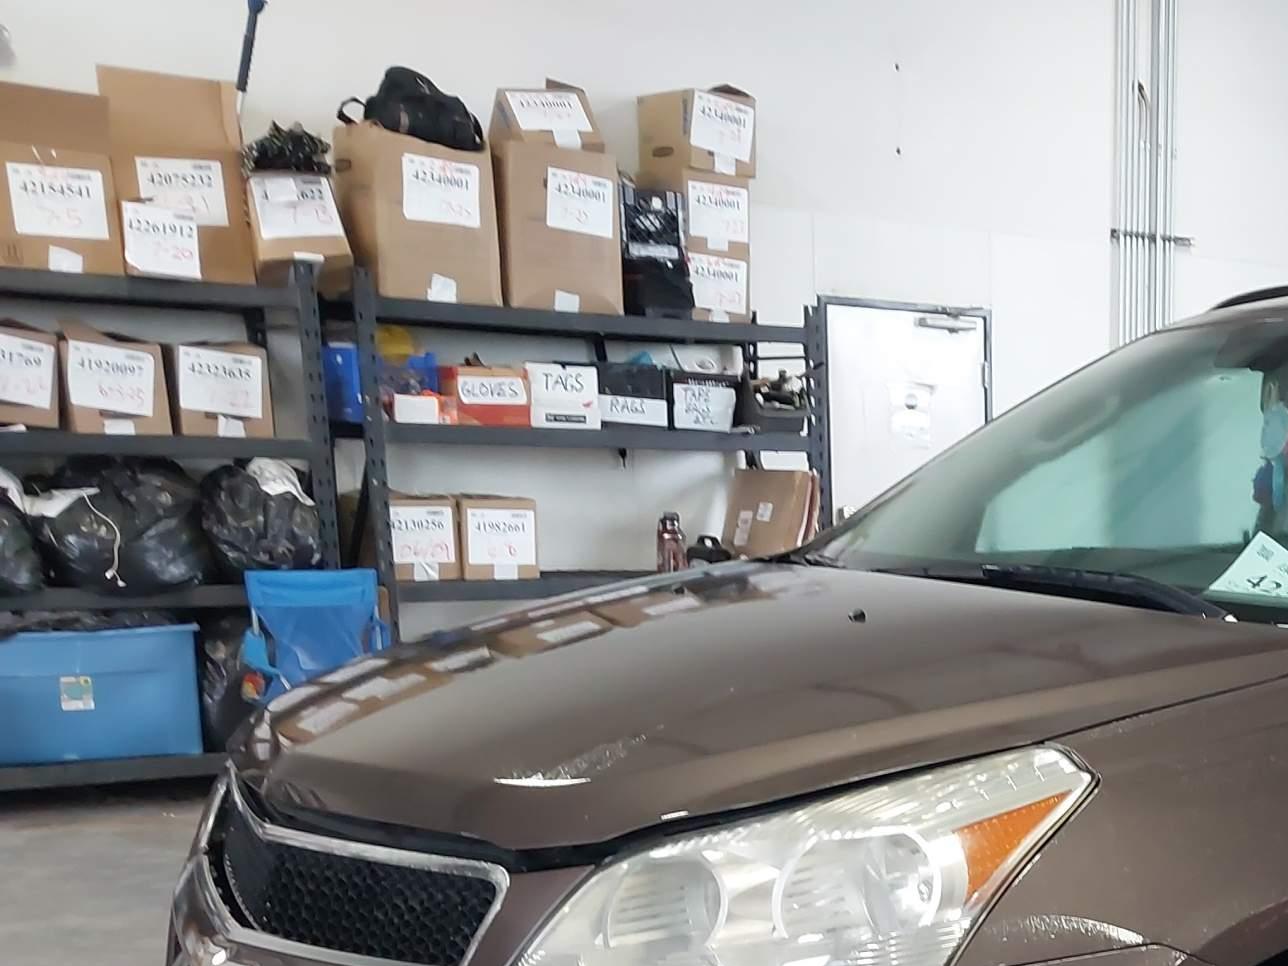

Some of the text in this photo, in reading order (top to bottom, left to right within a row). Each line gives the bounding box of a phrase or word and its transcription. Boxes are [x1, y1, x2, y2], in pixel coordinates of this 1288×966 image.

[461, 380, 520, 399] GLOVES
[542, 372, 585, 394] TAGS
[609, 396, 646, 415] RAGS
